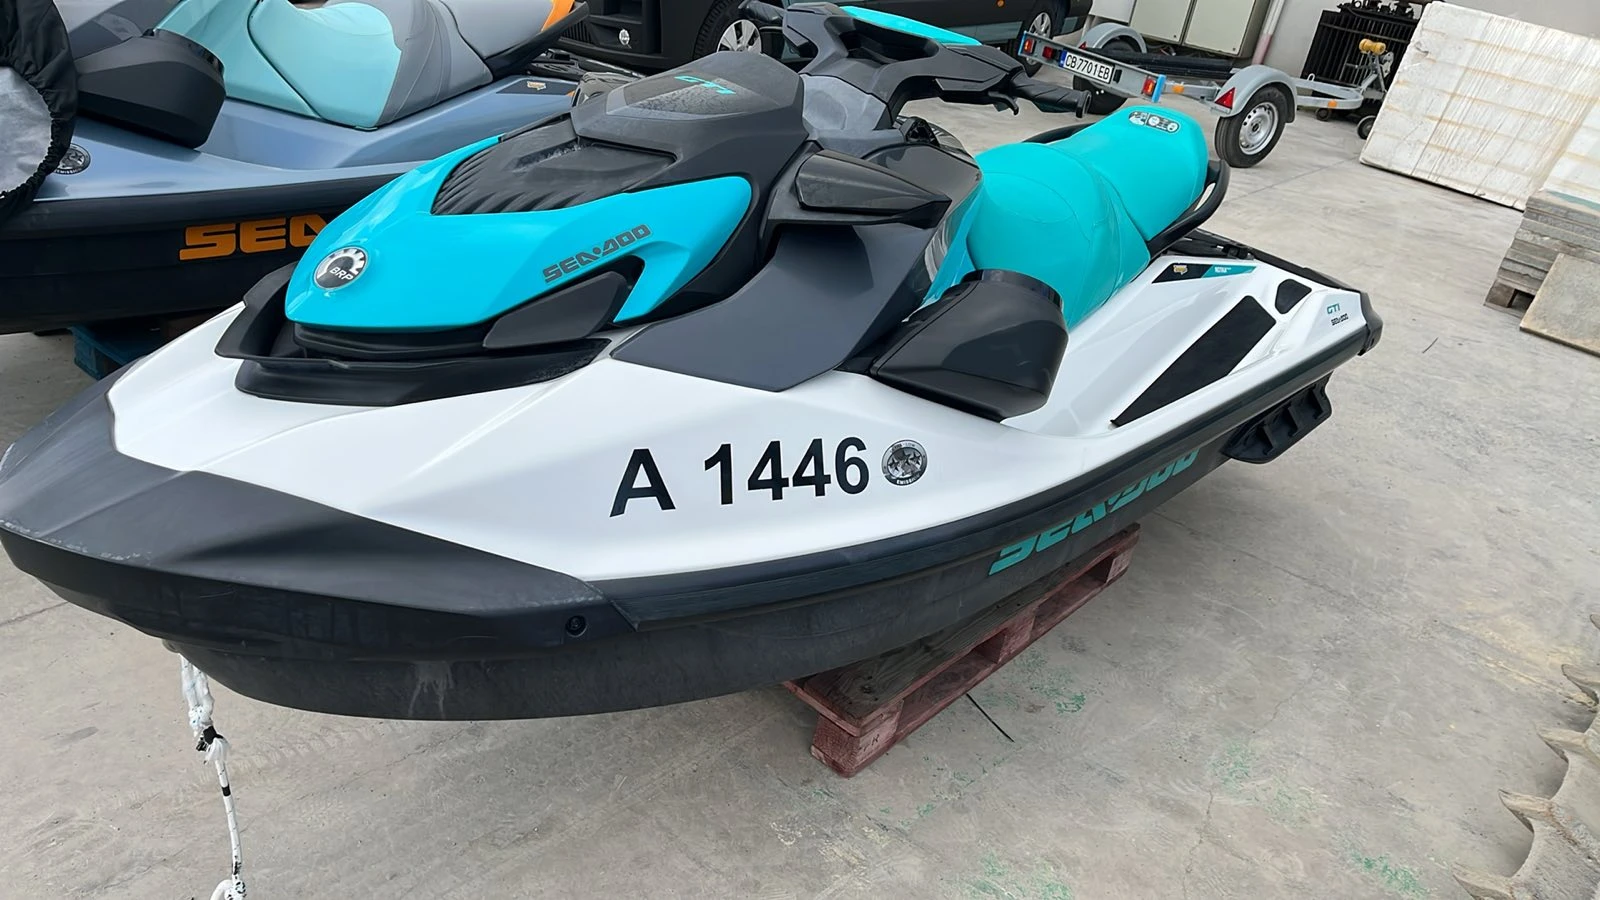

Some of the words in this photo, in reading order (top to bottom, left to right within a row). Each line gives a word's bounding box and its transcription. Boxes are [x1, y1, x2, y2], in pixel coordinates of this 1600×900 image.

[330, 267, 354, 281] BRP
[1326, 303, 1340, 315] GTI
[609, 448, 676, 517] A
[704, 436, 870, 505] 1446
